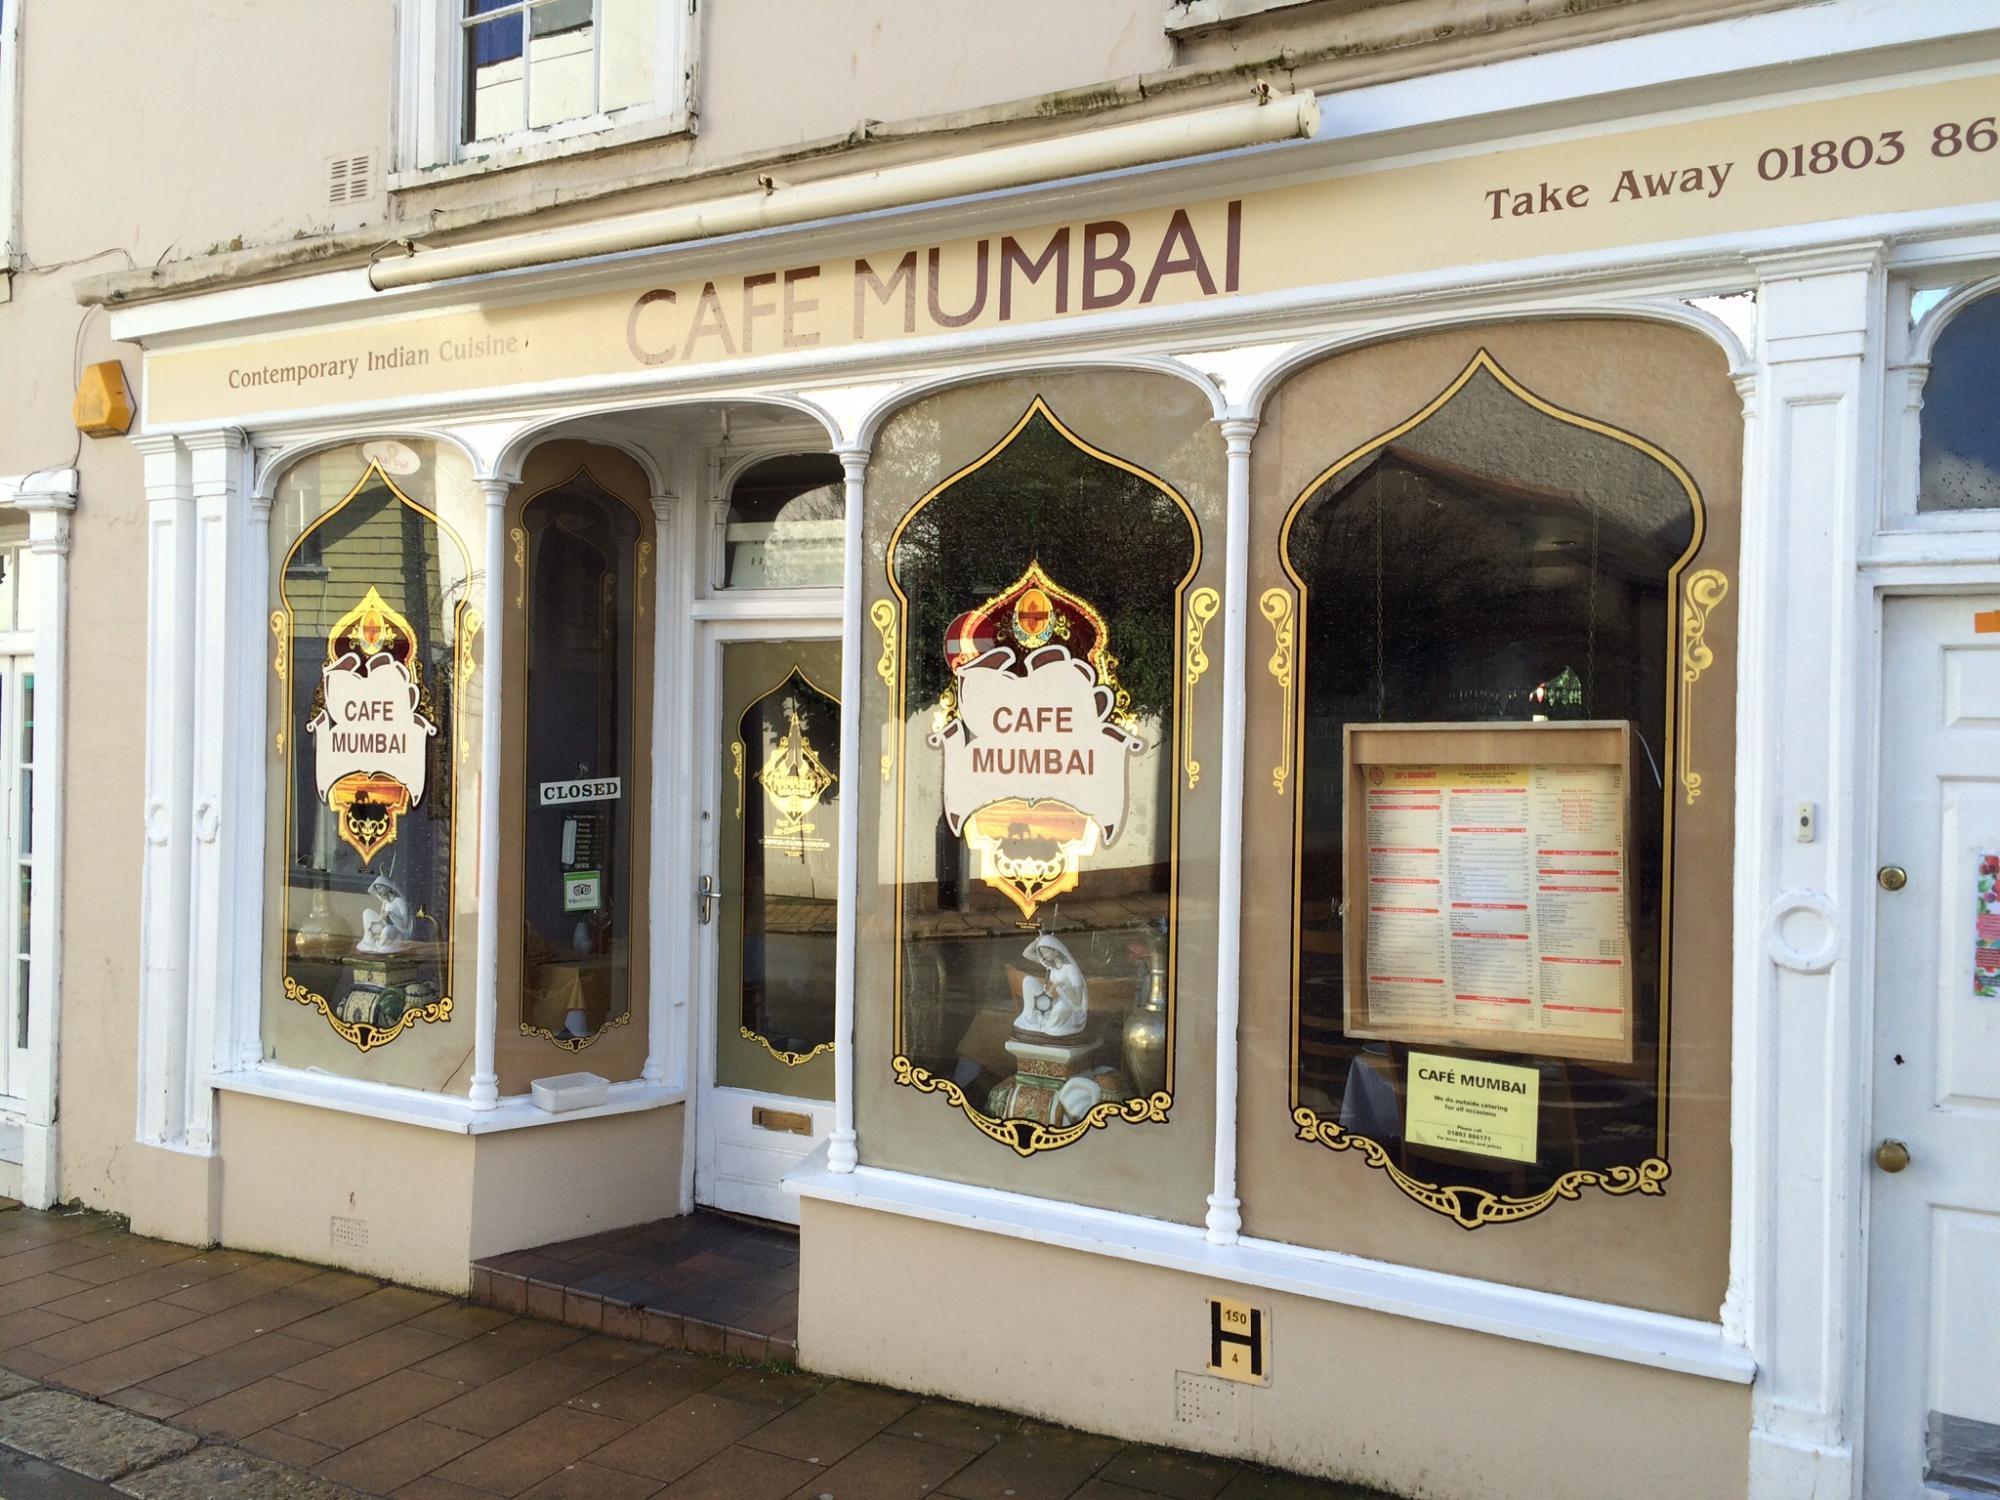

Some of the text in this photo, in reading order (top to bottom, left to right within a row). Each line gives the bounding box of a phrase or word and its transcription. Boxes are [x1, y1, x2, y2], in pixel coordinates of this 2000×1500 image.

[1484, 117, 2000, 220] Take Away 01803 86
[625, 199, 1243, 368] CAFE MUMBAI
[228, 335, 519, 389] Contemporary Indian Cuisine
[344, 700, 394, 722] CAFE
[992, 706, 1073, 734] CAFE
[332, 732, 406, 754] MUMBAI
[972, 747, 1094, 775] MUMBAI
[543, 782, 618, 801] CLOSED
[1418, 1068, 1526, 1094] CAFÉ MUMBAI
[1455, 1098, 1479, 1107] outside
[1480, 1103, 1508, 1113] catering
[1465, 1108, 1496, 1117] occasions
[1226, 1309, 1247, 1325] 150
[1211, 1300, 1262, 1376] H
[1232, 1353, 1239, 1364] 4
